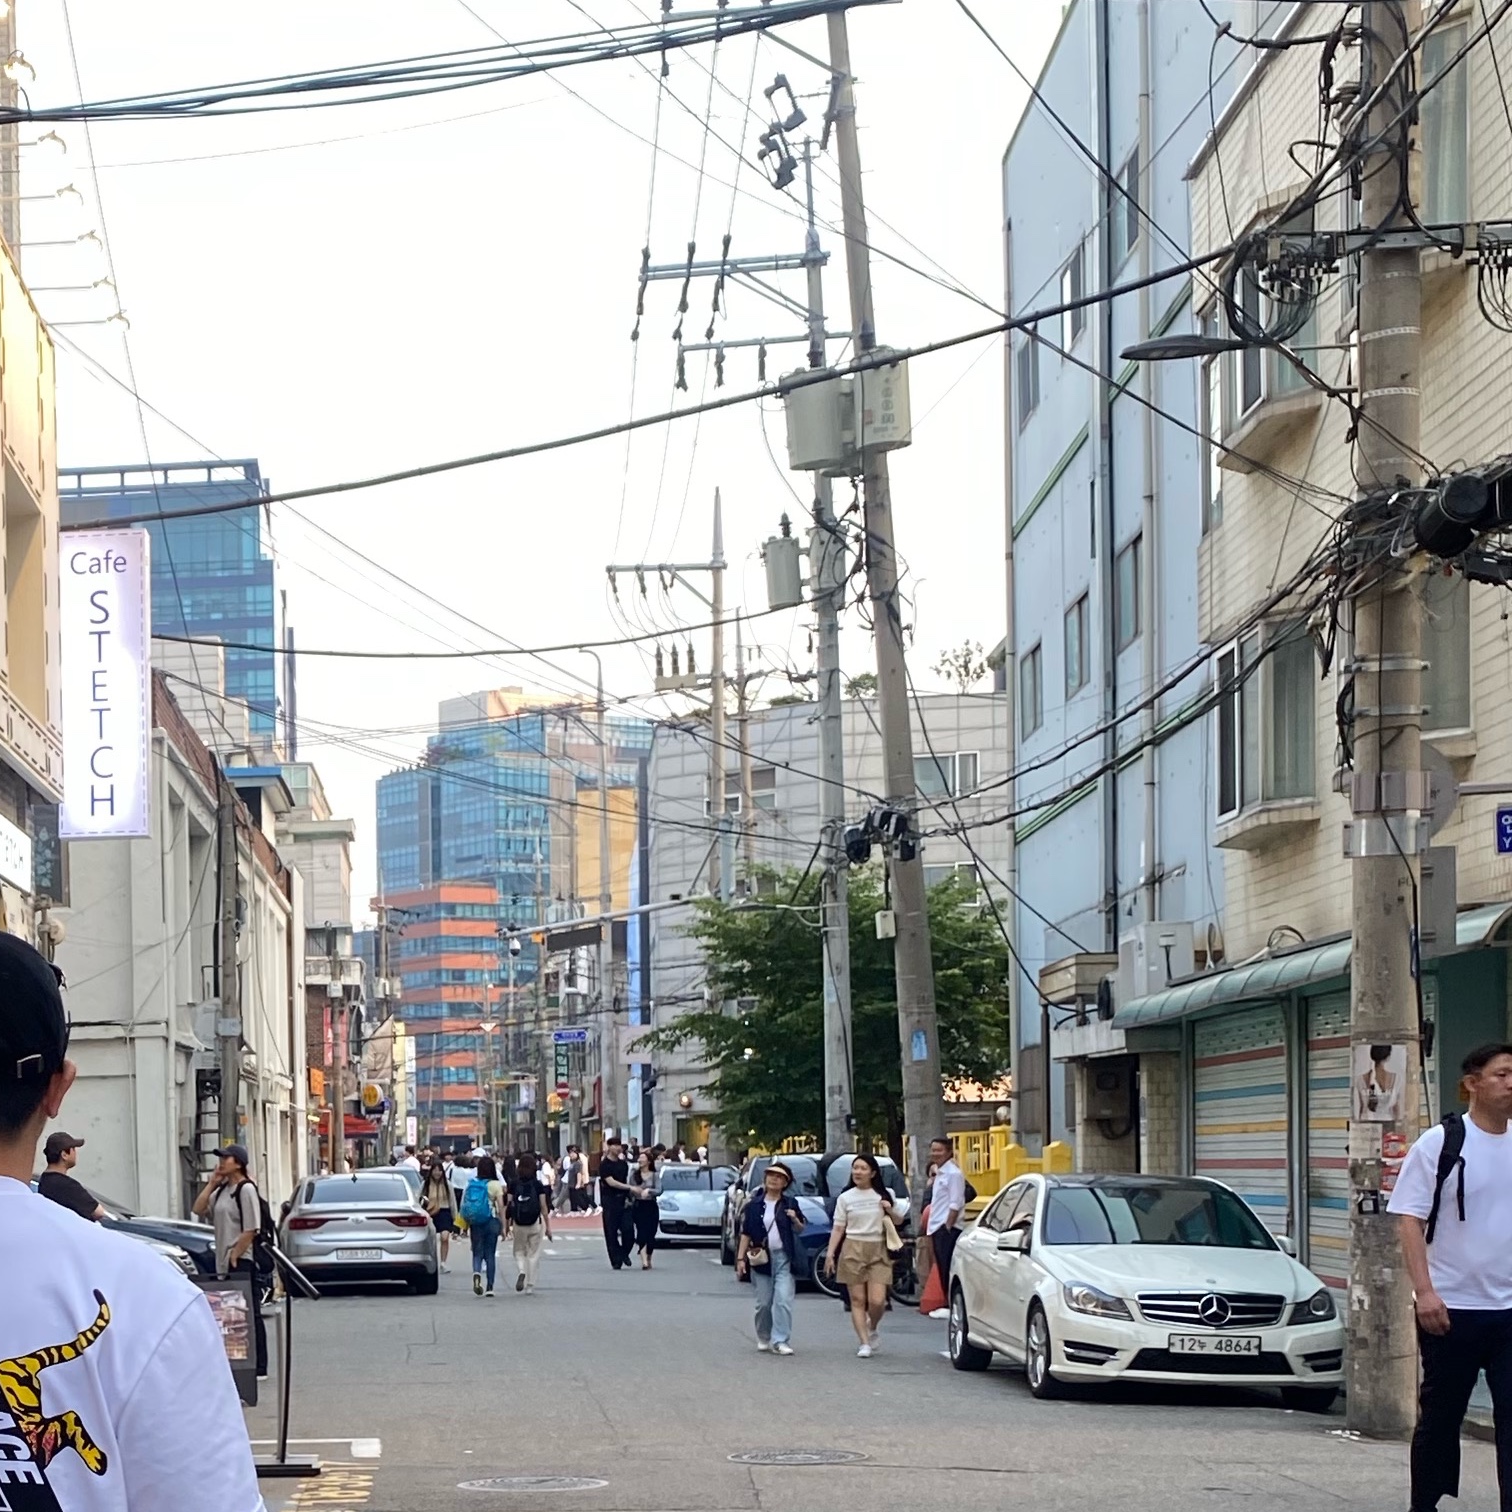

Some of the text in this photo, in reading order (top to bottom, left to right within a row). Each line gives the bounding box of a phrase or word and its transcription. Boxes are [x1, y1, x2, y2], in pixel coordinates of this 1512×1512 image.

[70, 549, 127, 575] Cafe
[89, 590, 115, 817] STETCH
[1214, 1339, 1252, 1353] 4864
